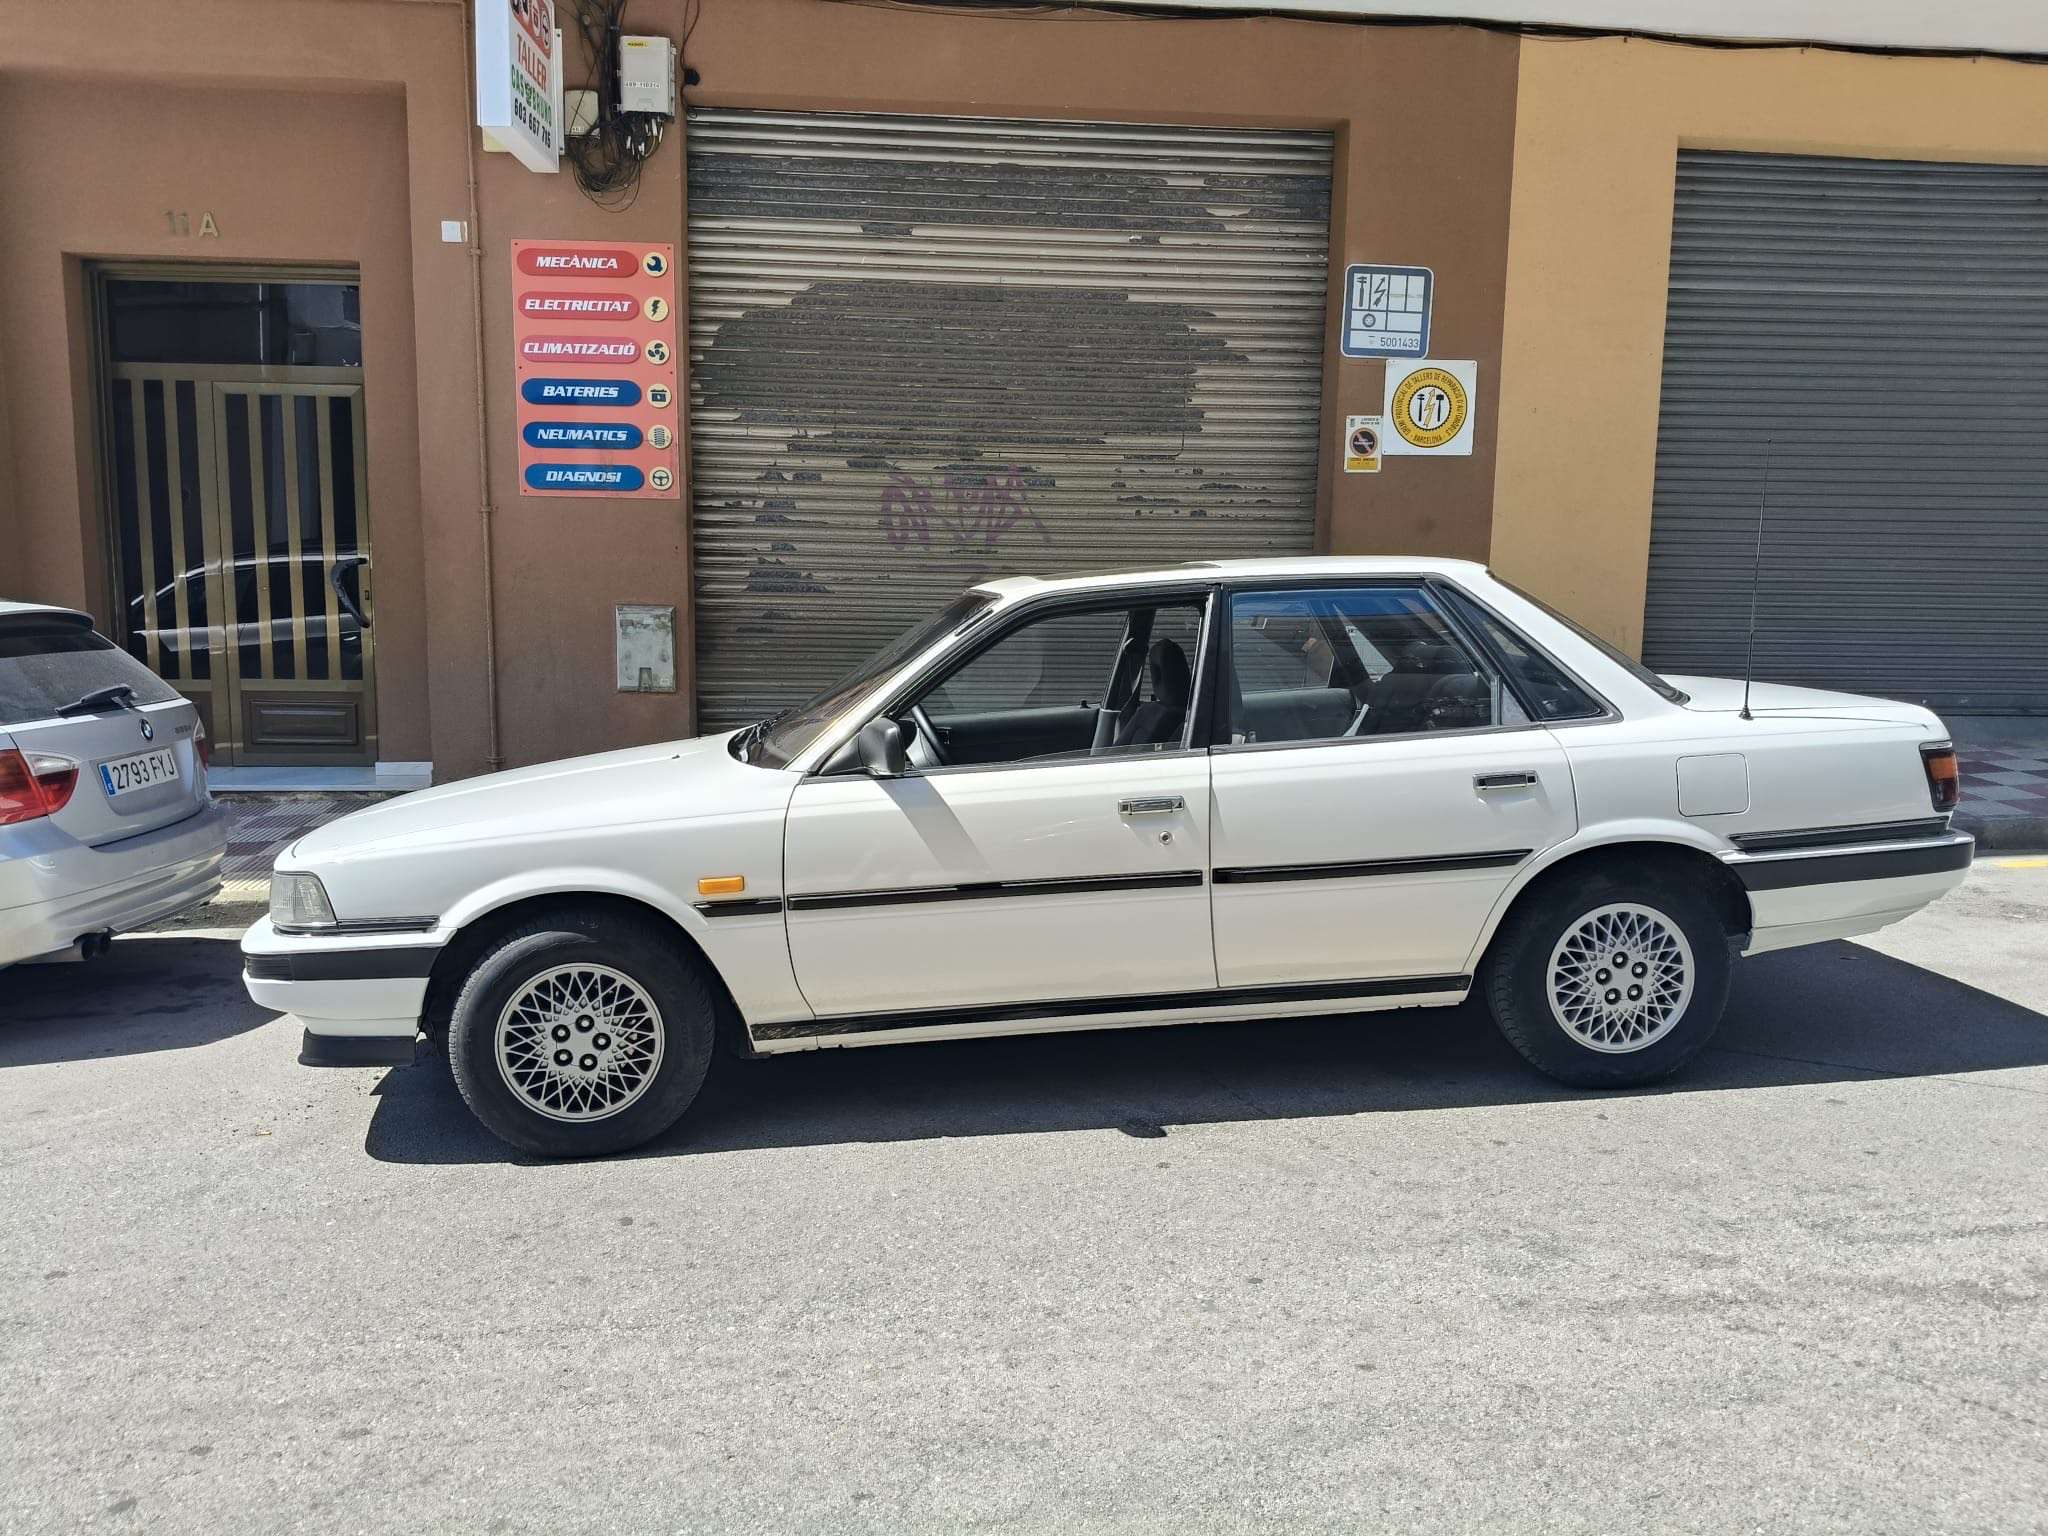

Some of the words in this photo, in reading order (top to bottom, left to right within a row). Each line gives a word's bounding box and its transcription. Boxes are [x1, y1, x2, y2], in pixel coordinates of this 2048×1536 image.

[517, 33, 547, 93] TALLER
[514, 97, 527, 124] 603
[528, 113, 540, 136] 667
[541, 126, 551, 148] 715
[199, 210, 219, 238] A
[536, 254, 618, 269] MECÀNICA
[525, 298, 632, 312] ELECTRICITAT
[523, 342, 636, 356] CLIMATIZACIÓ
[1380, 336, 1419, 348] 5001433
[543, 385, 620, 398] BATERIES
[537, 428, 628, 441] NEUMATICS
[546, 470, 622, 483] DIAGNOSI
[112, 759, 150, 790] 2793
[149, 753, 175, 779] FYJ
